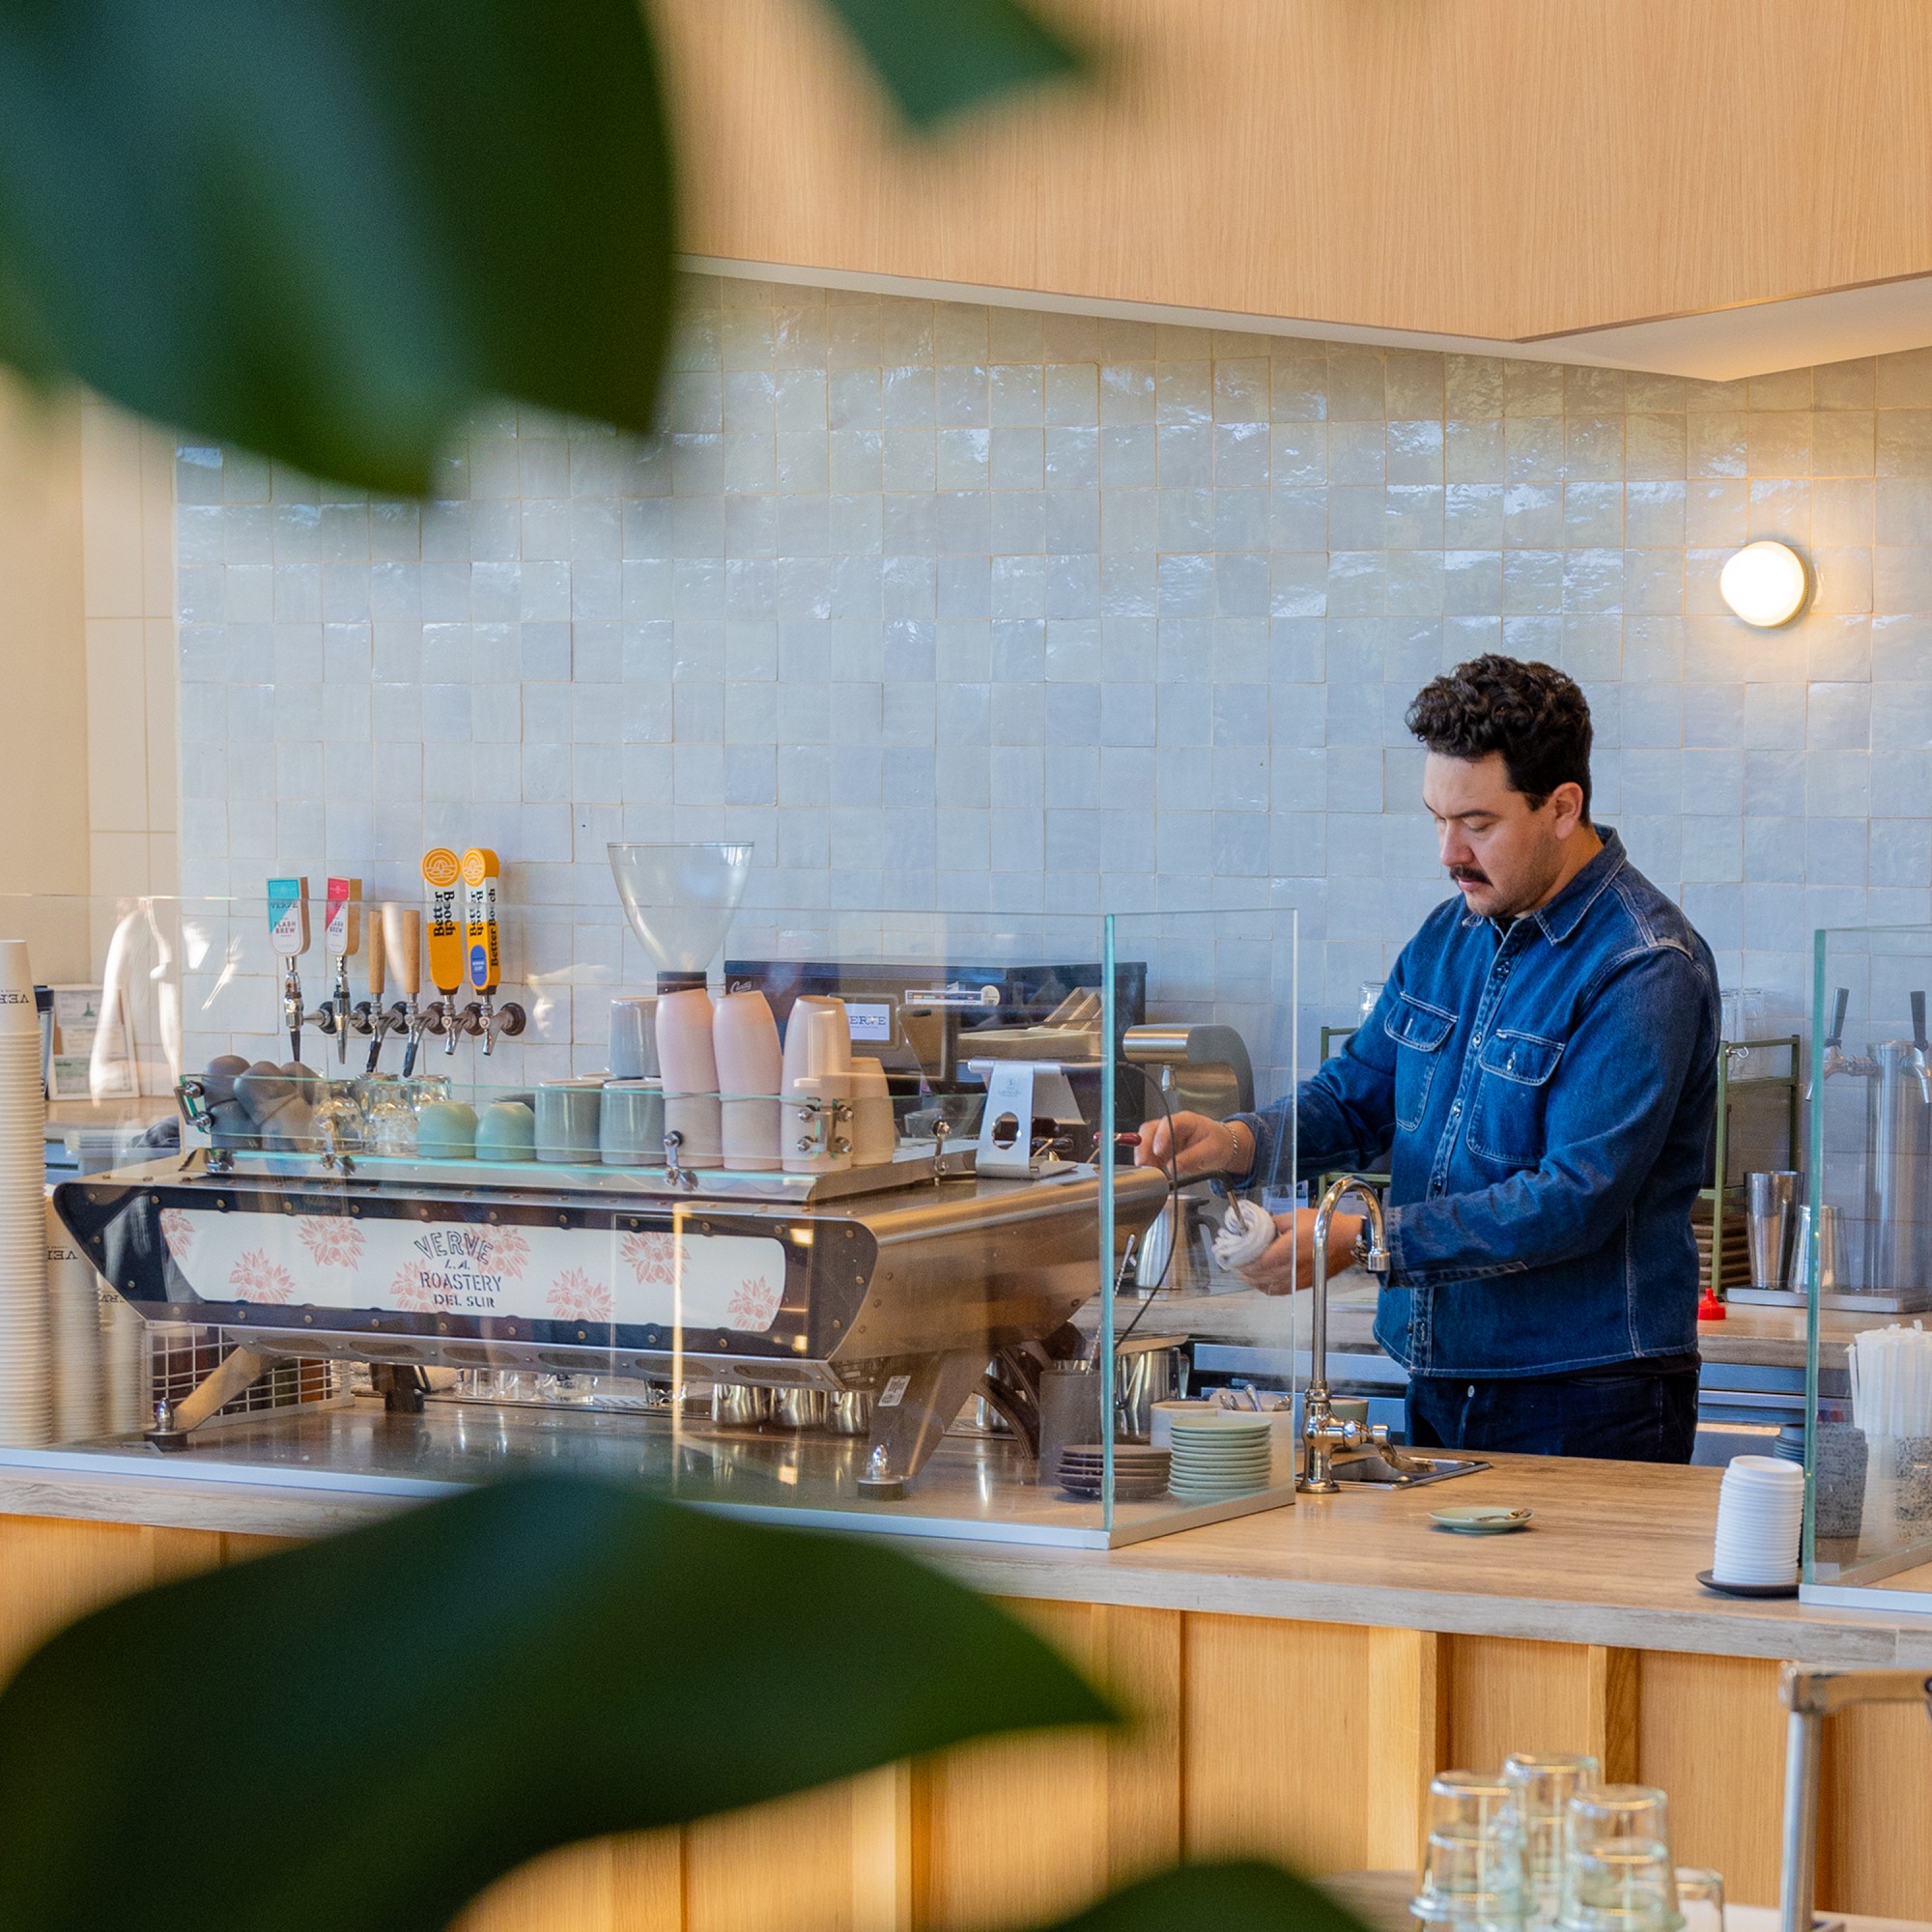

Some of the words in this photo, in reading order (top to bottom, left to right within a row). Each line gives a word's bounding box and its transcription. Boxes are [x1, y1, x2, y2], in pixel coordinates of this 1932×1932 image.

[489, 927, 498, 967] Better
[849, 1015, 887, 1026] ERVE
[413, 1230, 495, 1265] VERVE
[444, 1259, 471, 1270] L.A.
[419, 1271, 501, 1292] ROASTERY
[434, 1293, 463, 1306] DEL
[467, 1295, 496, 1308] SUR
